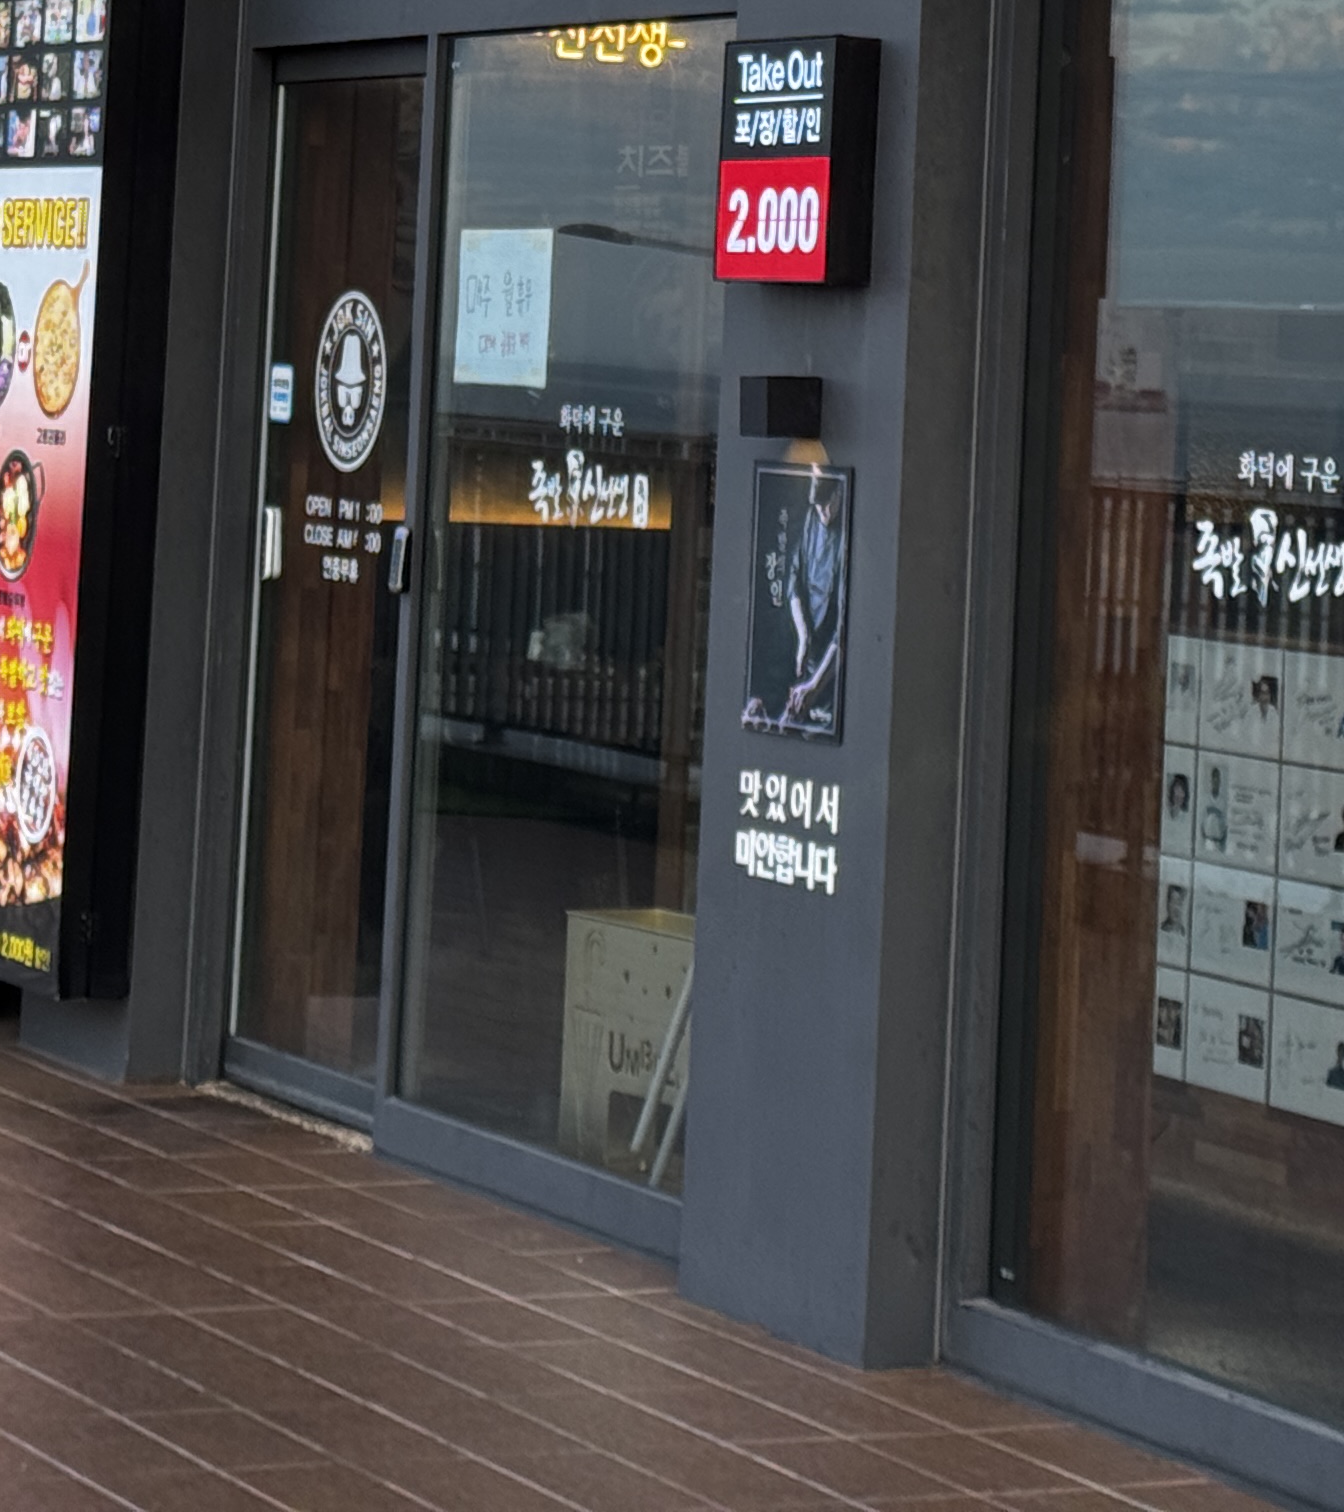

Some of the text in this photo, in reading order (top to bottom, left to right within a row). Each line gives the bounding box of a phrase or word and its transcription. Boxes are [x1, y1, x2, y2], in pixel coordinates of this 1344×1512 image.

[737, 49, 824, 93] Take Out
[733, 106, 822, 147] 포/장/할/인
[725, 186, 820, 255] 2.000
[598, 406, 625, 438] 구운
[1237, 449, 1341, 494] 화덕에 구운
[305, 494, 333, 519] OPEN
[303, 523, 335, 548] CLOSE
[738, 768, 840, 835] 맛있어서
[734, 828, 838, 896] 미안합니다
